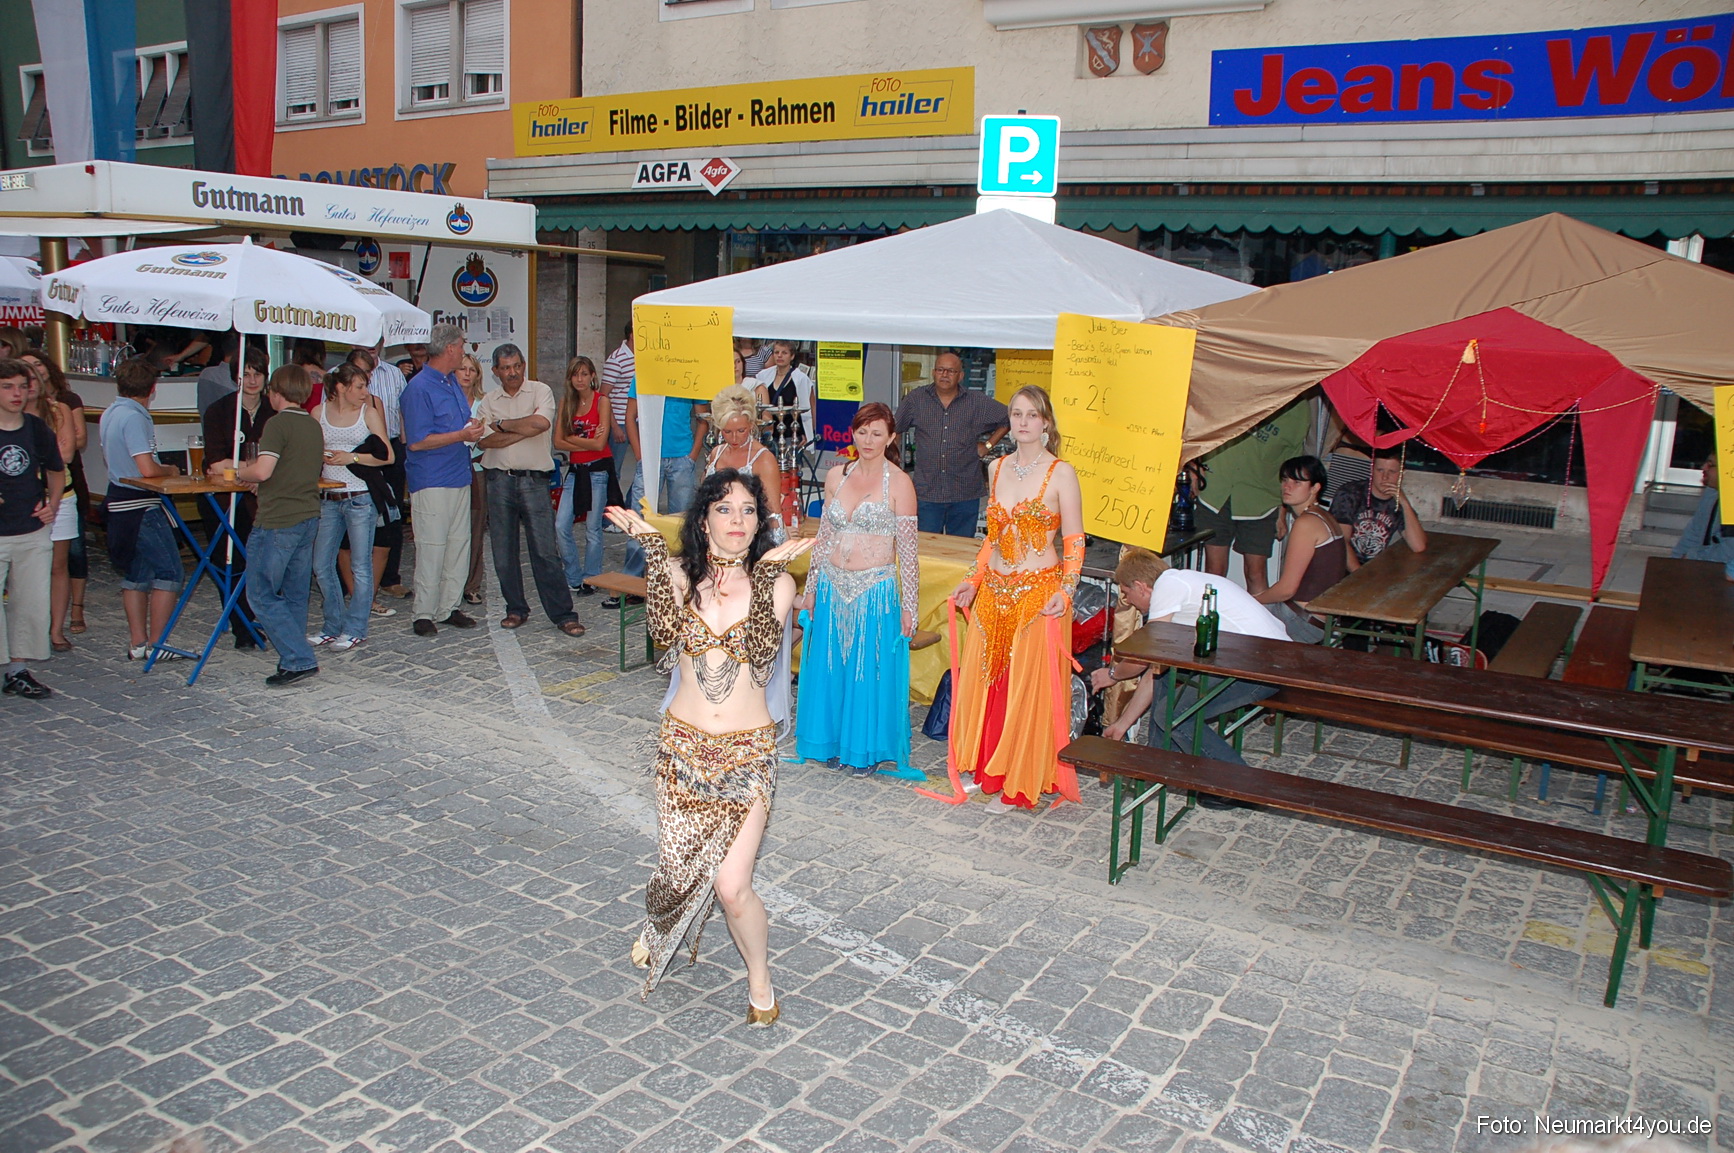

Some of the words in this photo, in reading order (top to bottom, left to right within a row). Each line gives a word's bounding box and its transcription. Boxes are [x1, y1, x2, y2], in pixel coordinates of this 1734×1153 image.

[870, 77, 901, 93] FOTO
[1232, 53, 1514, 117] Jeans
[537, 104, 559, 117] FOTO
[861, 92, 944, 117] hailer
[609, 109, 657, 135] Filme
[676, 102, 732, 131] Bilder
[750, 97, 835, 127] Rahmen
[531, 118, 588, 138] hailer
[998, 126, 1040, 184] P
[637, 161, 691, 183] AGFA
[703, 165, 728, 178] Agfa
[192, 181, 305, 216] Gutmann
[325, 203, 356, 221] Gutes
[366, 207, 430, 231] Hefeweizen
[136, 264, 227, 279] Gutmann
[98, 295, 140, 314] Gutes
[144, 298, 220, 322] Hefeweizen
[254, 299, 357, 333] Gutmann
[1063, 396, 1078, 407] nur
[823, 424, 853, 443] Red
[1145, 462, 1162, 474] mit
